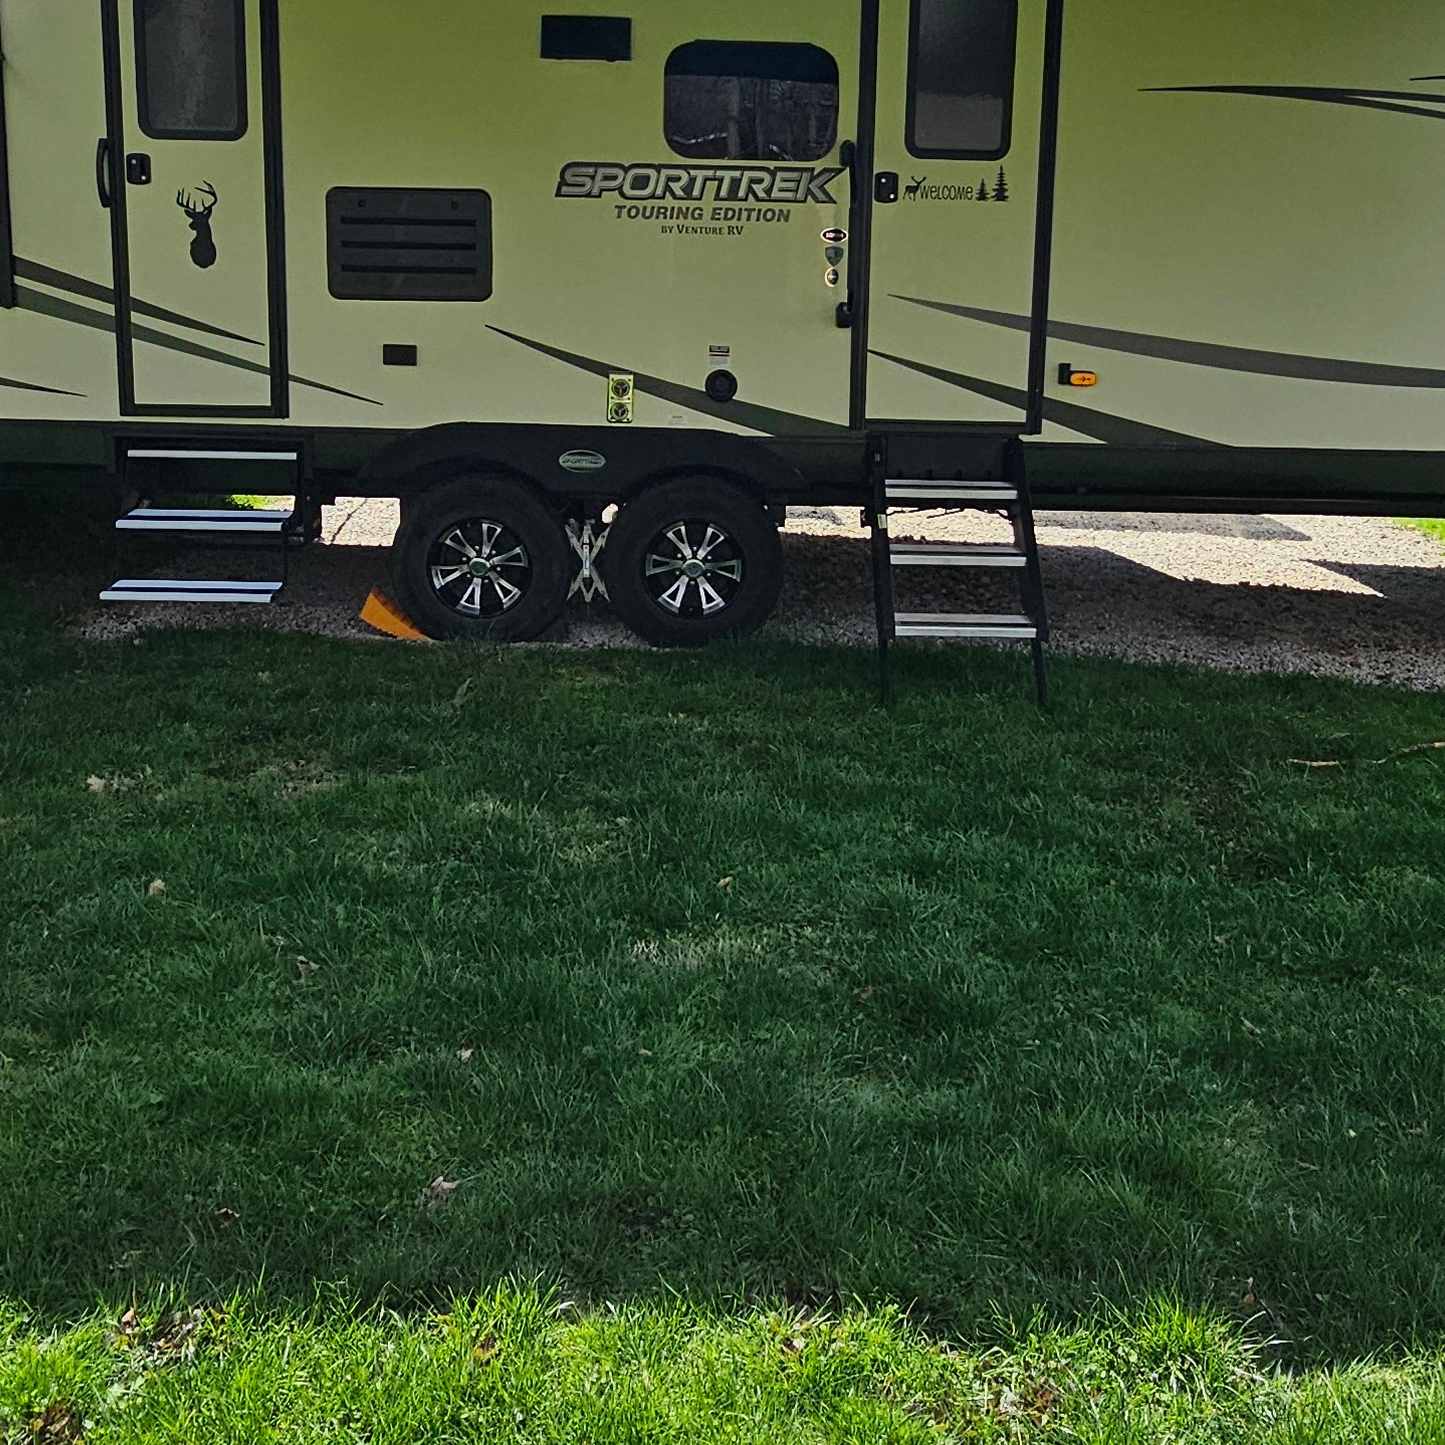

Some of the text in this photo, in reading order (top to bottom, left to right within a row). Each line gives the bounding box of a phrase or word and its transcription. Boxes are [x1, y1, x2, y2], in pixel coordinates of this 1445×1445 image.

[556, 162, 845, 204] SPORTTREK
[614, 205, 791, 223] TOURING EDITION
[661, 224, 744, 236] BY VENTURE RV
